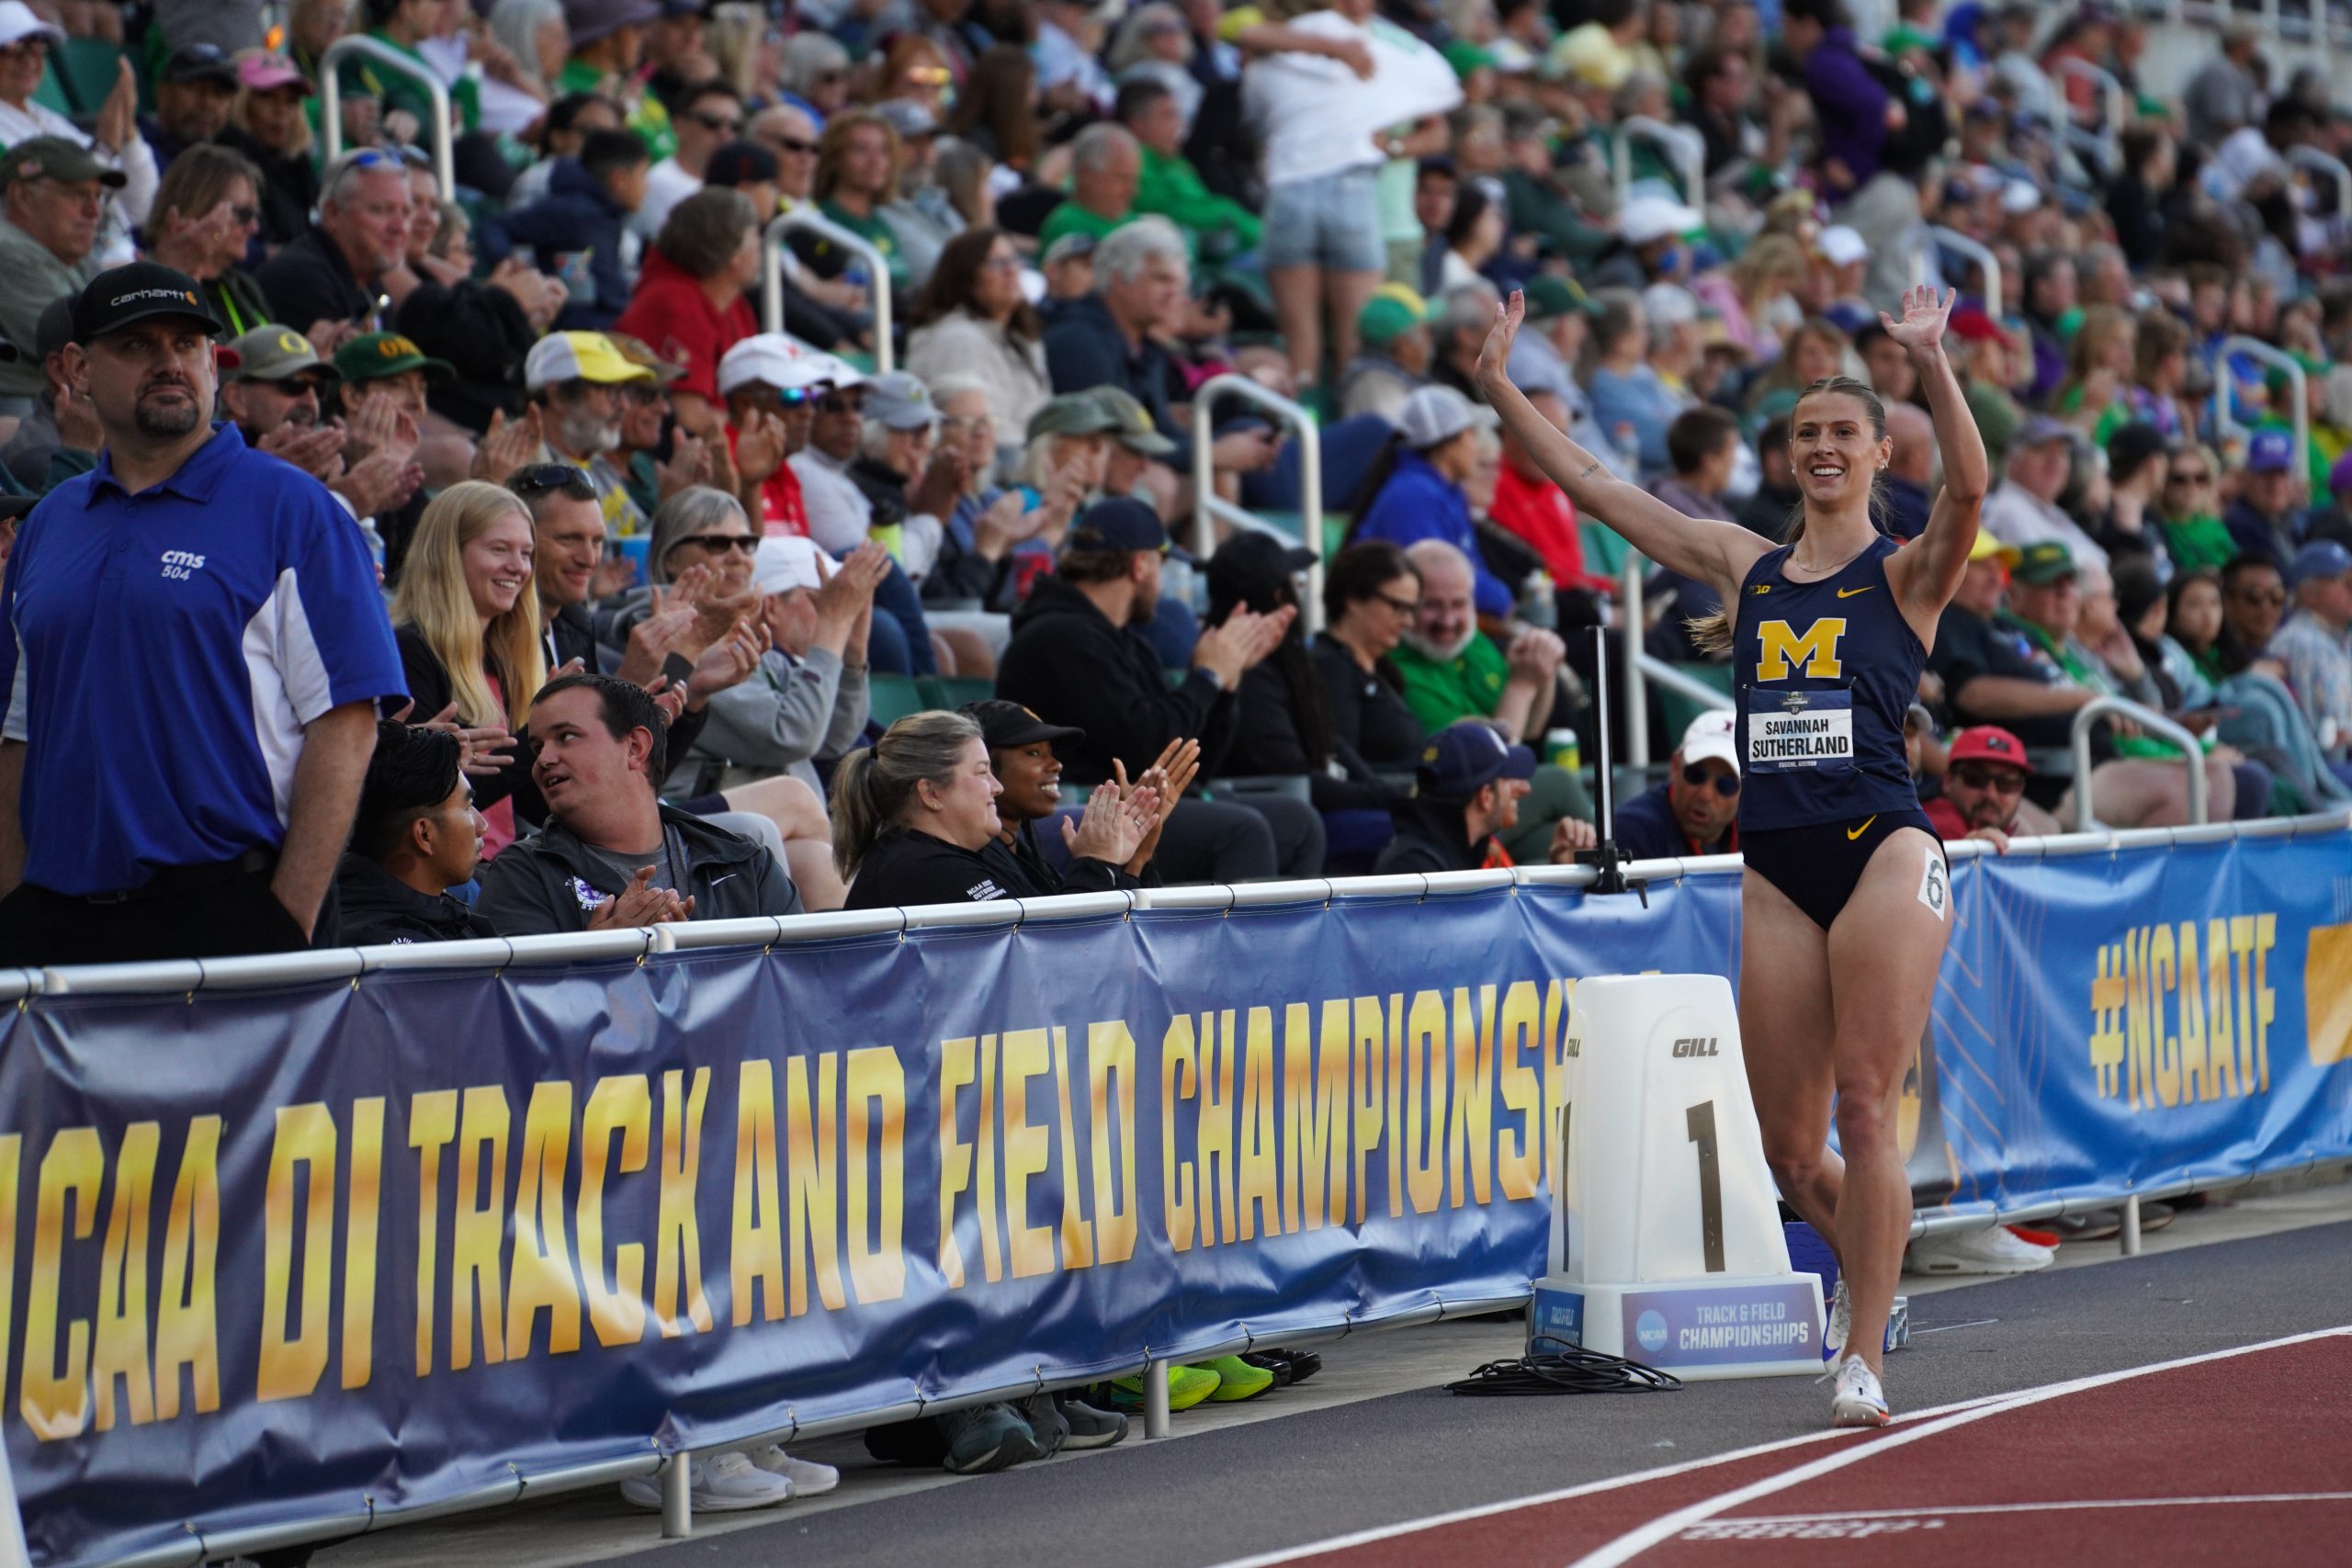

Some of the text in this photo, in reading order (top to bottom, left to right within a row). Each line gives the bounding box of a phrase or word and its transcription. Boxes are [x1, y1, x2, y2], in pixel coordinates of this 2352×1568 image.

[110, 288, 186, 307] carhartt
[161, 549, 206, 569] cms
[161, 564, 191, 581] 504
[1756, 617, 1847, 682] M
[1765, 719, 1829, 736] SAVANNAH
[1752, 736, 1849, 759] SUTHERLAND
[967, 884, 983, 896] NCAA
[1926, 858, 1946, 910] 6
[2089, 912, 2278, 1114] #NCAATF
[1566, 1038, 1580, 1058] GILL
[1672, 1037, 1719, 1058] GILL
[256, 1096, 386, 1403] DI
[408, 1066, 713, 1378] TRACK
[732, 1045, 905, 1327] AND
[938, 1019, 1137, 1288] FIELD
[1162, 976, 1577, 1251] CHAMPIONSH
[1686, 1099, 1726, 1273] 1
[1697, 1303, 1785, 1325] TRACK & FIELD
[1679, 1322, 1809, 1350] CHAMPIONSHIPS
